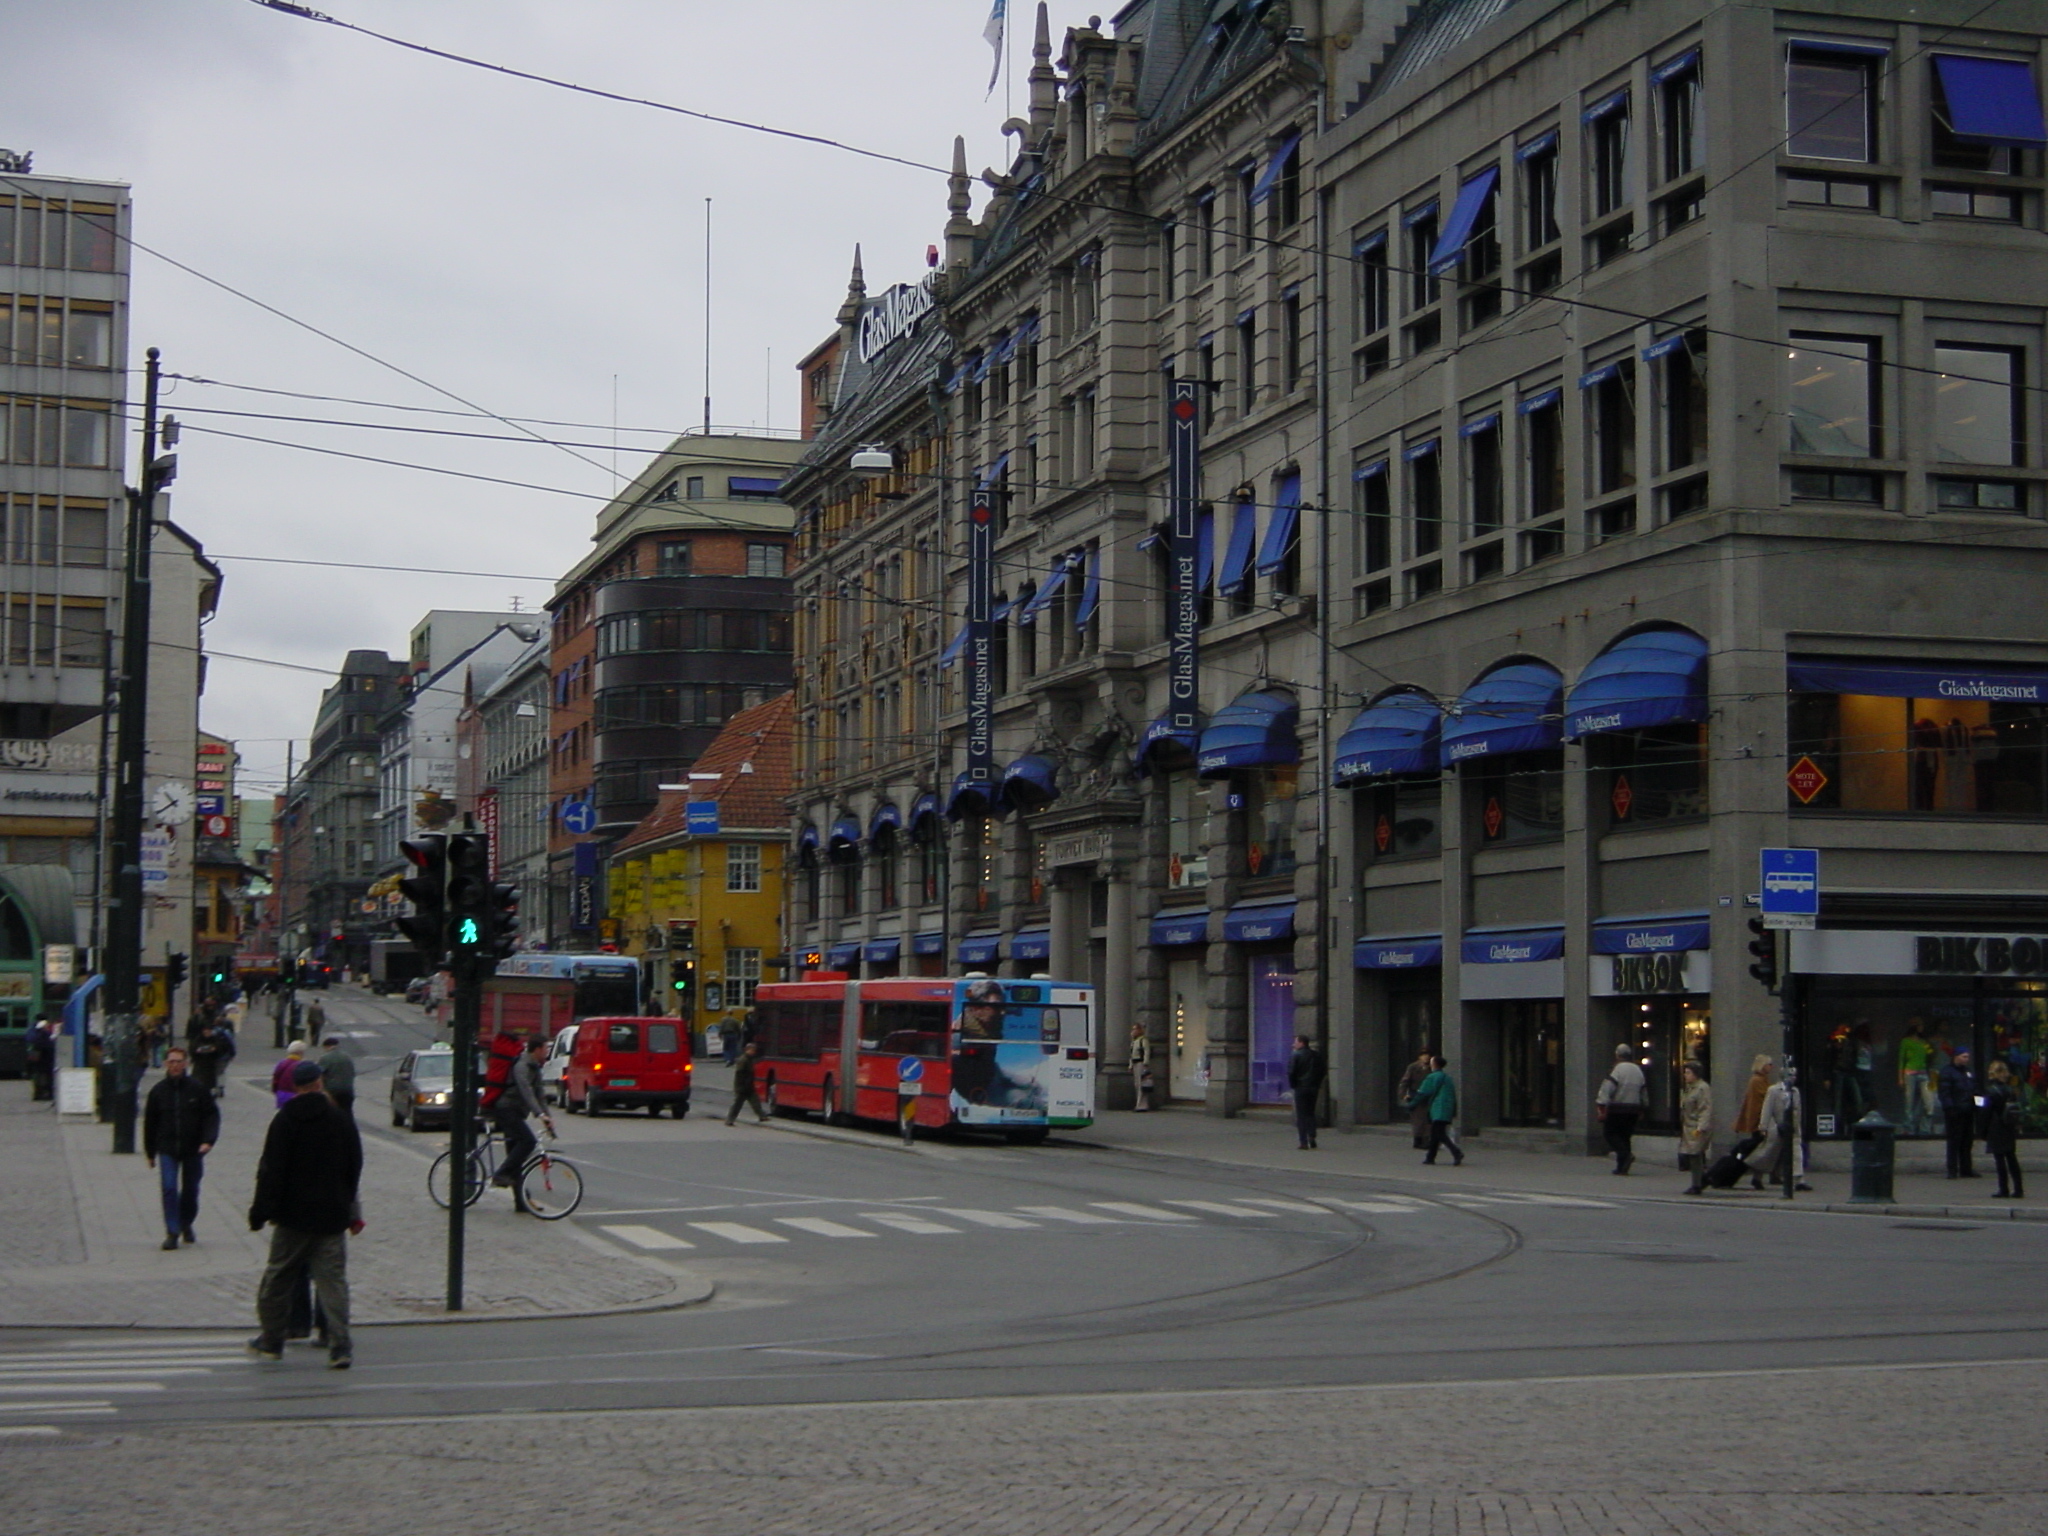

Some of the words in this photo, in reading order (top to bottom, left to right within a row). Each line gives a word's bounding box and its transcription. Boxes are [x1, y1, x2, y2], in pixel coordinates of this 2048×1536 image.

[1174, 555, 1197, 699] GlasMagasinet
[971, 637, 991, 756] GlasMagasinet
[1938, 679, 2038, 700] GlasMagasinet
